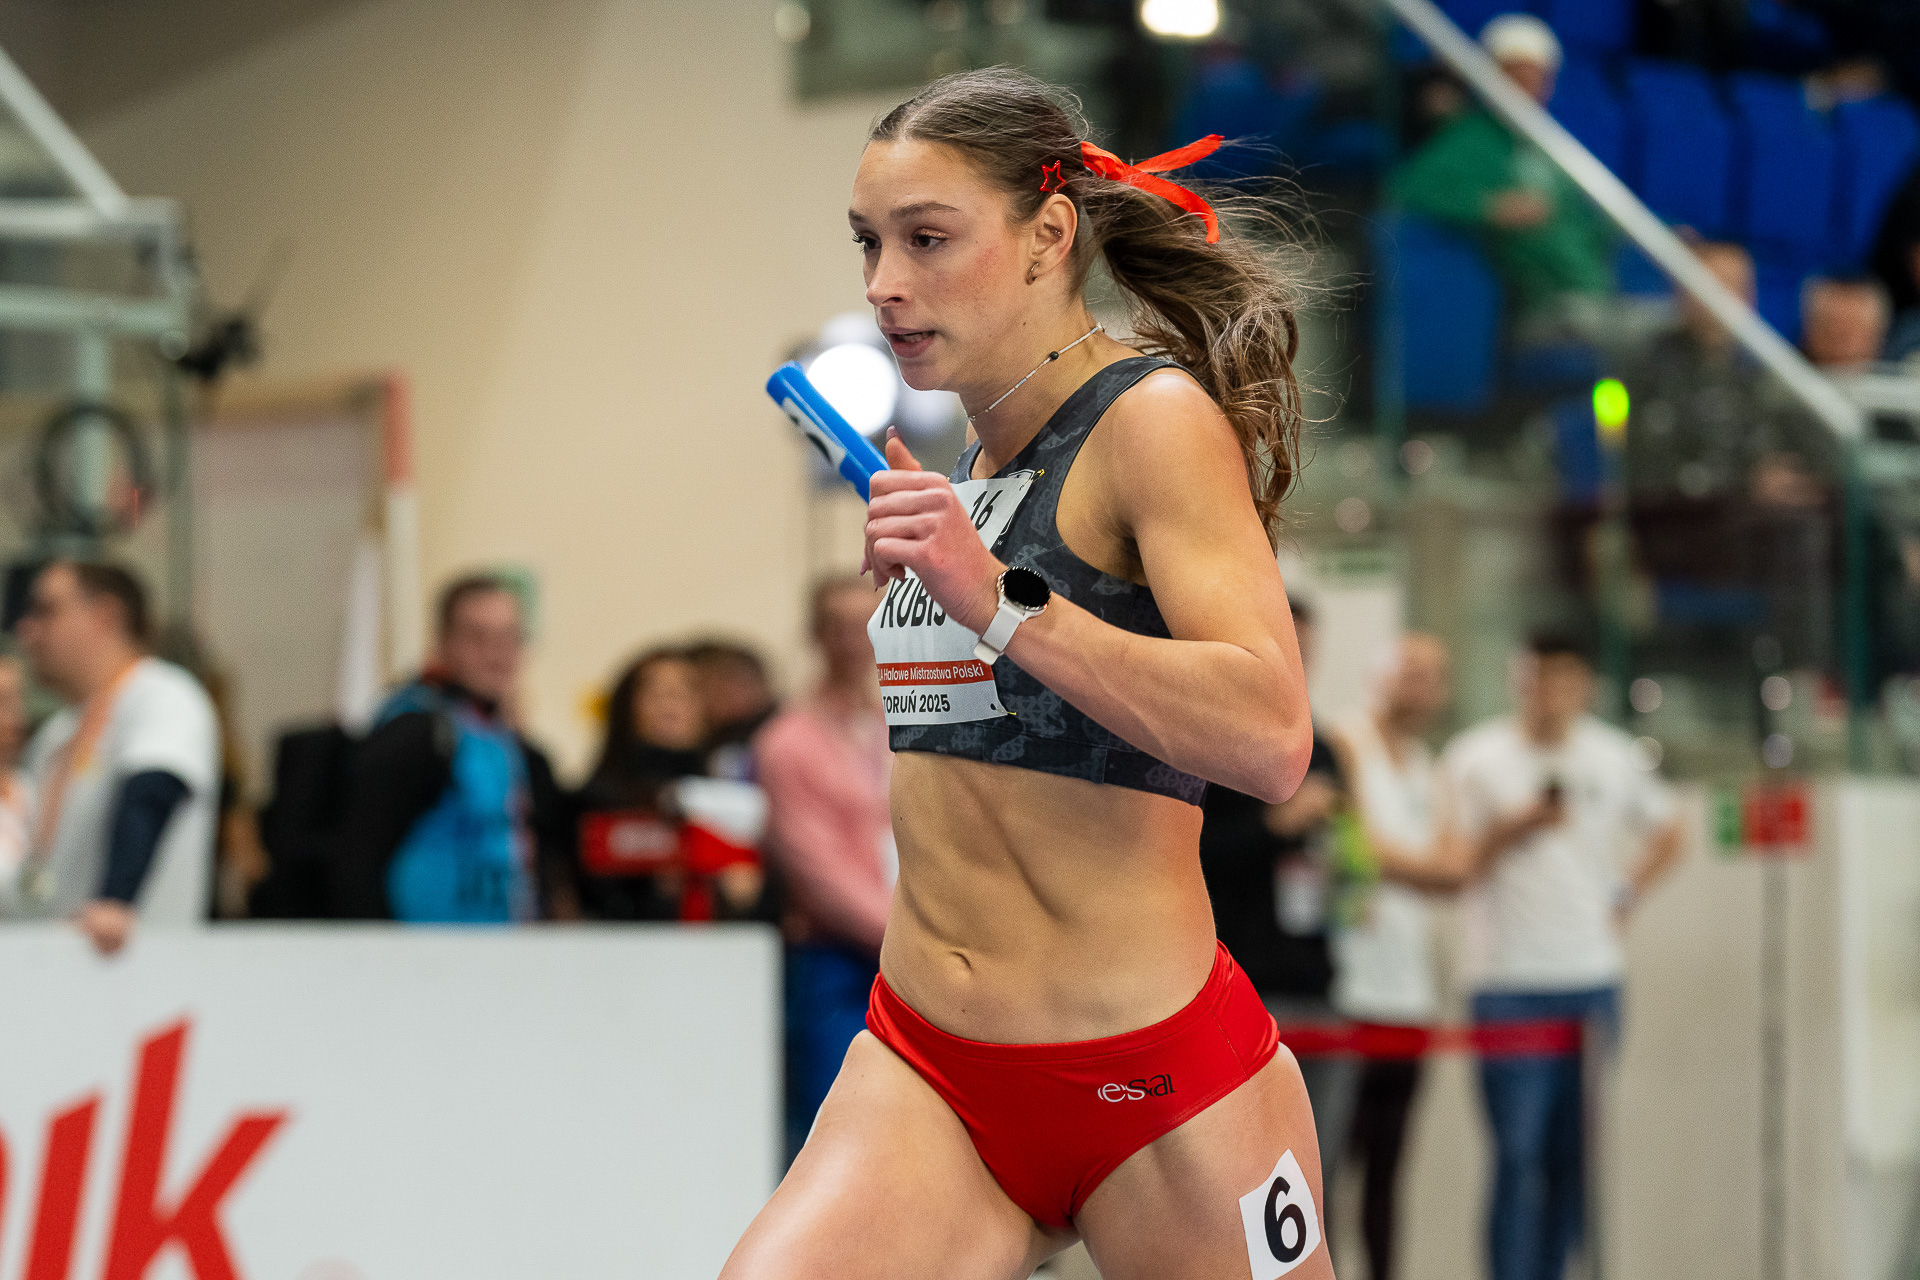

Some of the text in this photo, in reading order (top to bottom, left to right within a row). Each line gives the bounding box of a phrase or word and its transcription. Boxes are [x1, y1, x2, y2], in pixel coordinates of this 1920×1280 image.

[883, 667, 909, 681] Halowe
[910, 666, 952, 681] Mistrzostwa
[953, 663, 985, 679] Polski
[882, 689, 951, 713] TORUŃ 2025
[1264, 1176, 1307, 1263] 6
